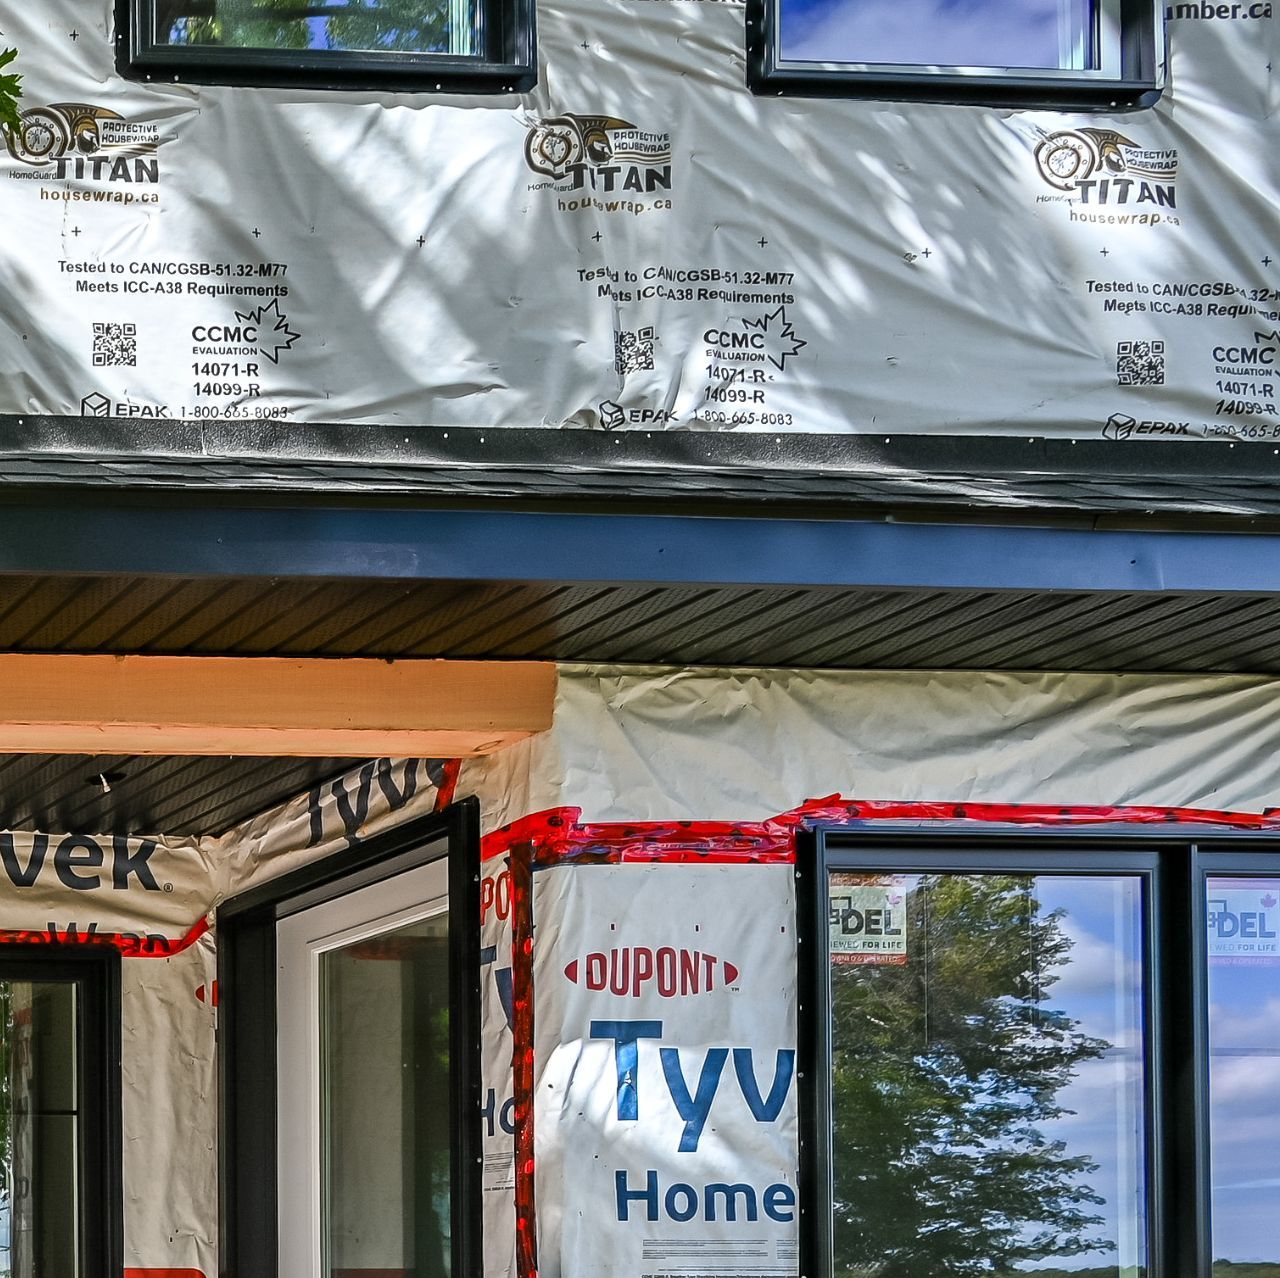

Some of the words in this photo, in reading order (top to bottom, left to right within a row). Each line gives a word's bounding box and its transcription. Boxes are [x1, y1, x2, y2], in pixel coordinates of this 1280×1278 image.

[102, 121, 158, 133] PROTECTIVE
[614, 131, 670, 142] PROTECTIVE
[614, 142, 671, 153] HOUSEWRAP
[50, 156, 159, 184] TITAN
[565, 165, 672, 193] TITAN
[40, 187, 159, 206] housewrap.ca
[1075, 179, 1177, 209] TITAN
[1070, 210, 1180, 227] housewrap.ca
[58, 260, 106, 274] Tested
[110, 261, 125, 274] to
[129, 261, 288, 277] CAN/CGSB-51.32-M77
[624, 270, 638, 282] to
[643, 266, 795, 286] CAN/CGSB-51.32-M77
[76, 280, 118, 293] Meets
[124, 281, 183, 294] ICC-A38
[187, 282, 289, 298] Requirements
[637, 285, 693, 301] ICC-A38
[697, 288, 795, 304] Requirements
[1086, 280, 1134, 294] Tested
[1137, 282, 1149, 294] to
[1104, 298, 1147, 313] Meets
[1150, 301, 1203, 316] ICC-A38
[192, 326, 258, 343] CCMC
[703, 329, 765, 349] CCMC
[192, 347, 258, 355] EVALUATION
[706, 350, 765, 362] EVALUATION
[1212, 346, 1275, 365] CCMC
[192, 363, 259, 377] 14071-R
[706, 364, 766, 383] 14071-R
[1215, 365, 1273, 377] EVALUATION
[193, 382, 261, 397] 14099-R
[705, 385, 765, 403] 14099-R
[1216, 380, 1275, 398] 14071-R
[115, 404, 168, 418] EPAK
[629, 409, 679, 423] EPAK
[1215, 399, 1279, 416] 14099-R
[1136, 421, 1190, 435] EPAK
[841, 908, 901, 936] DEL
[1217, 911, 1276, 938] DEL
[862, 941, 880, 949] FOR
[882, 941, 903, 949] LIFE
[1236, 944, 1255, 952] FOR
[1257, 944, 1277, 952] LIFE
[586, 946, 717, 998] DUPONT
[614, 1170, 796, 1222] Home
